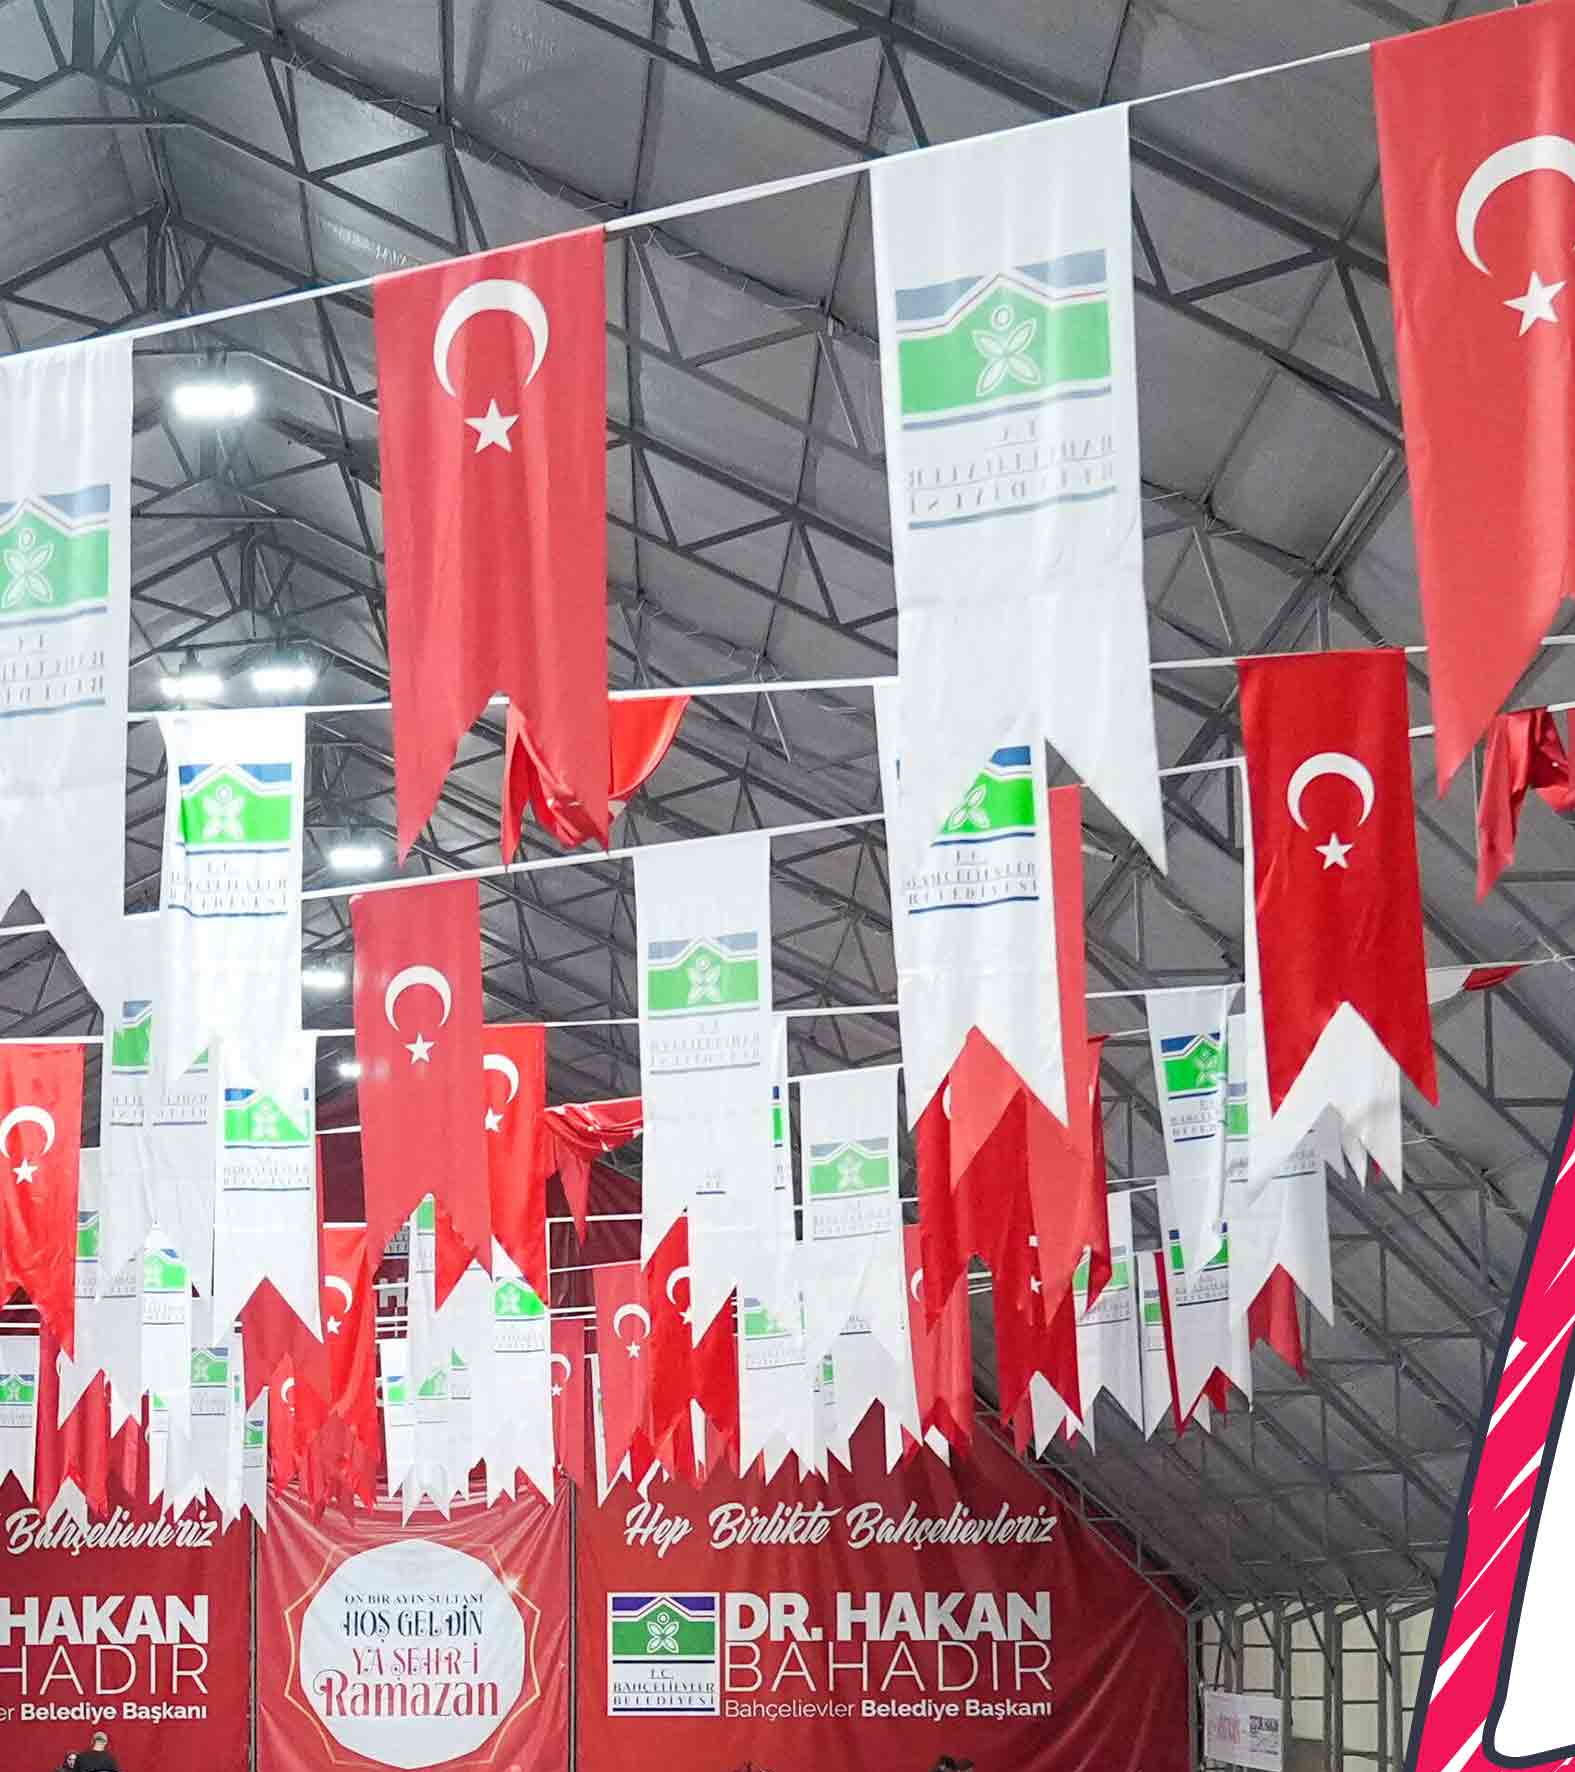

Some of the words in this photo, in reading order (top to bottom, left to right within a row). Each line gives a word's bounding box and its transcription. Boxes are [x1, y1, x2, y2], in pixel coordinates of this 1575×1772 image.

[623, 1501, 693, 1559] Hep
[708, 1501, 843, 1550] Birlikte
[846, 1500, 1058, 1550] Bahçelievleriz
[0, 1595, 209, 1645] HAKAN
[725, 1591, 823, 1642] DR.
[836, 1591, 1052, 1642] HAKAN
[725, 1641, 1053, 1692] BAHADIR
[21, 1702, 117, 1724] Belediye
[123, 1702, 208, 1724] Başkanı
[313, 1669, 499, 1717] Ramazan
[725, 1699, 856, 1721] Bahçelievler
[861, 1698, 960, 1721] Belediye
[965, 1699, 1053, 1721] Başkanı
